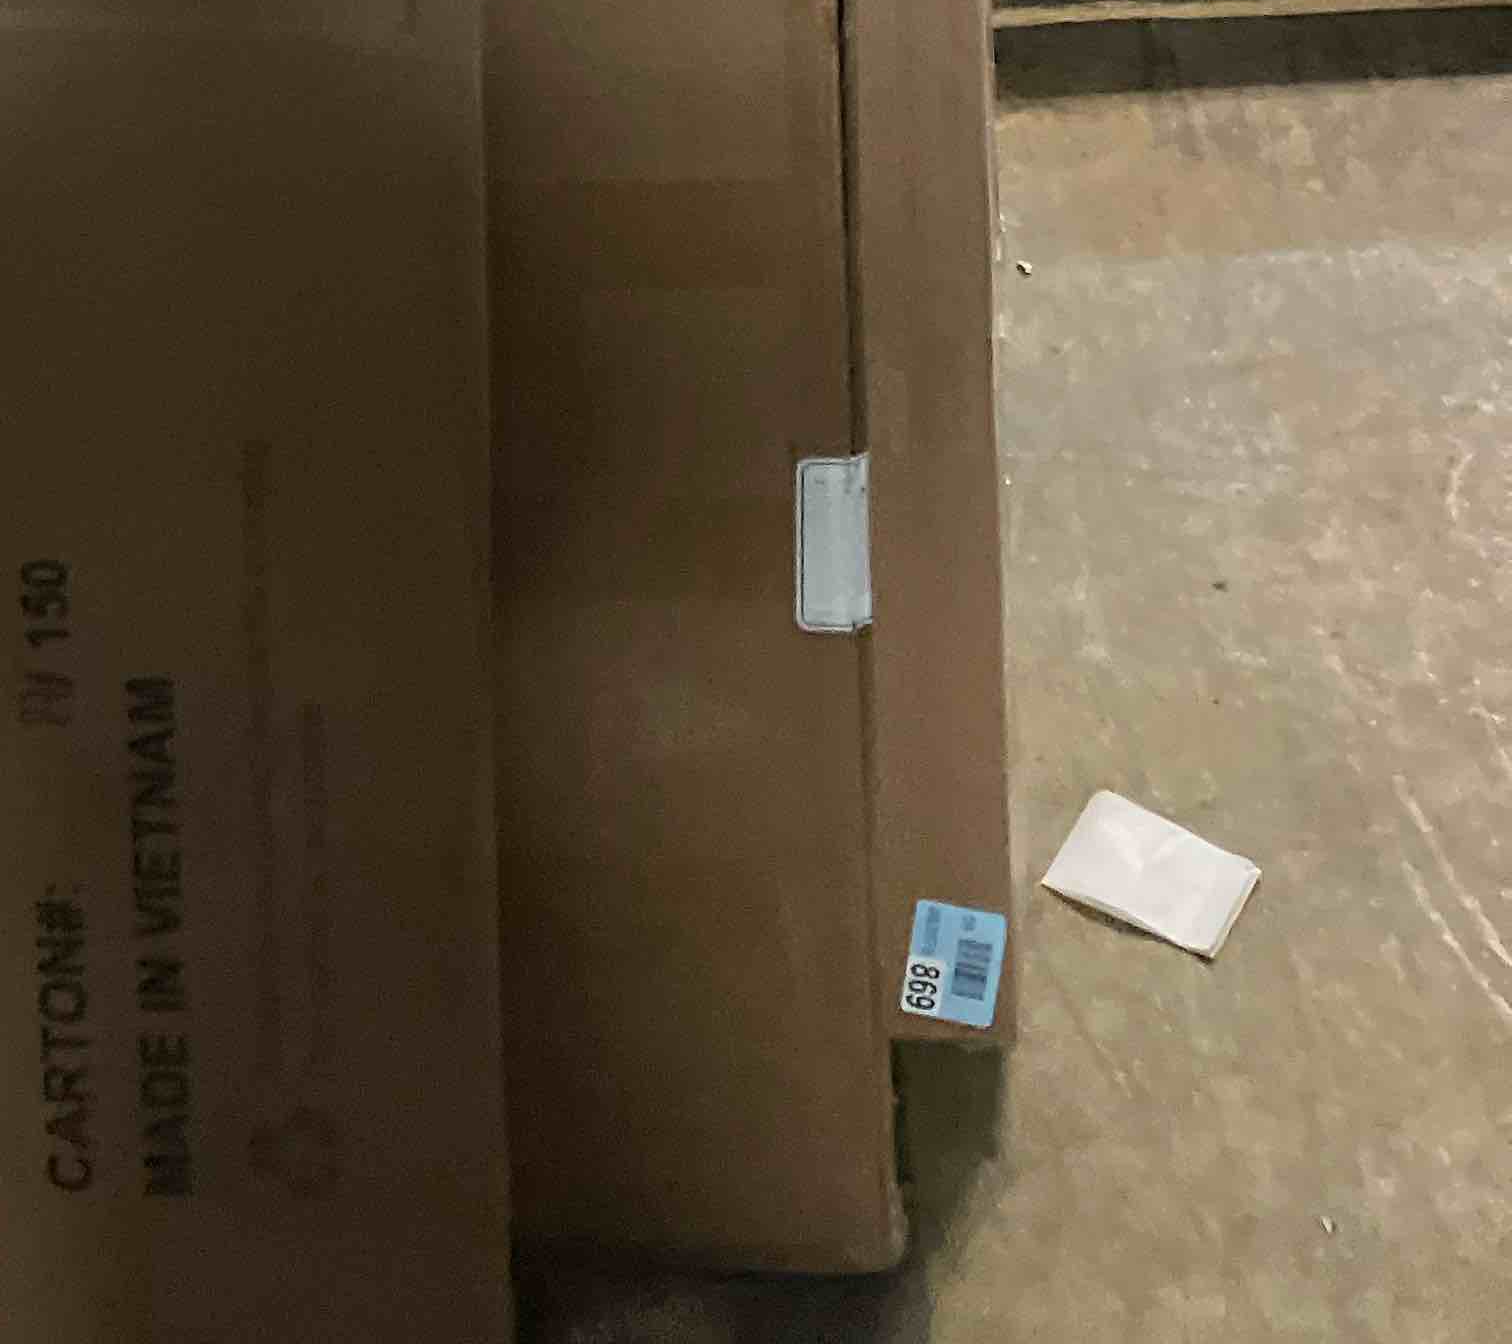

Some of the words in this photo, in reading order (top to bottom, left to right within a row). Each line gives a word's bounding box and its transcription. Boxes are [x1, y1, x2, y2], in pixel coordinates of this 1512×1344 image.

[19, 558, 74, 648] 150
[123, 674, 184, 938] VIETNAM
[133, 956, 185, 1014] IN
[138, 1032, 194, 1199] MADE
